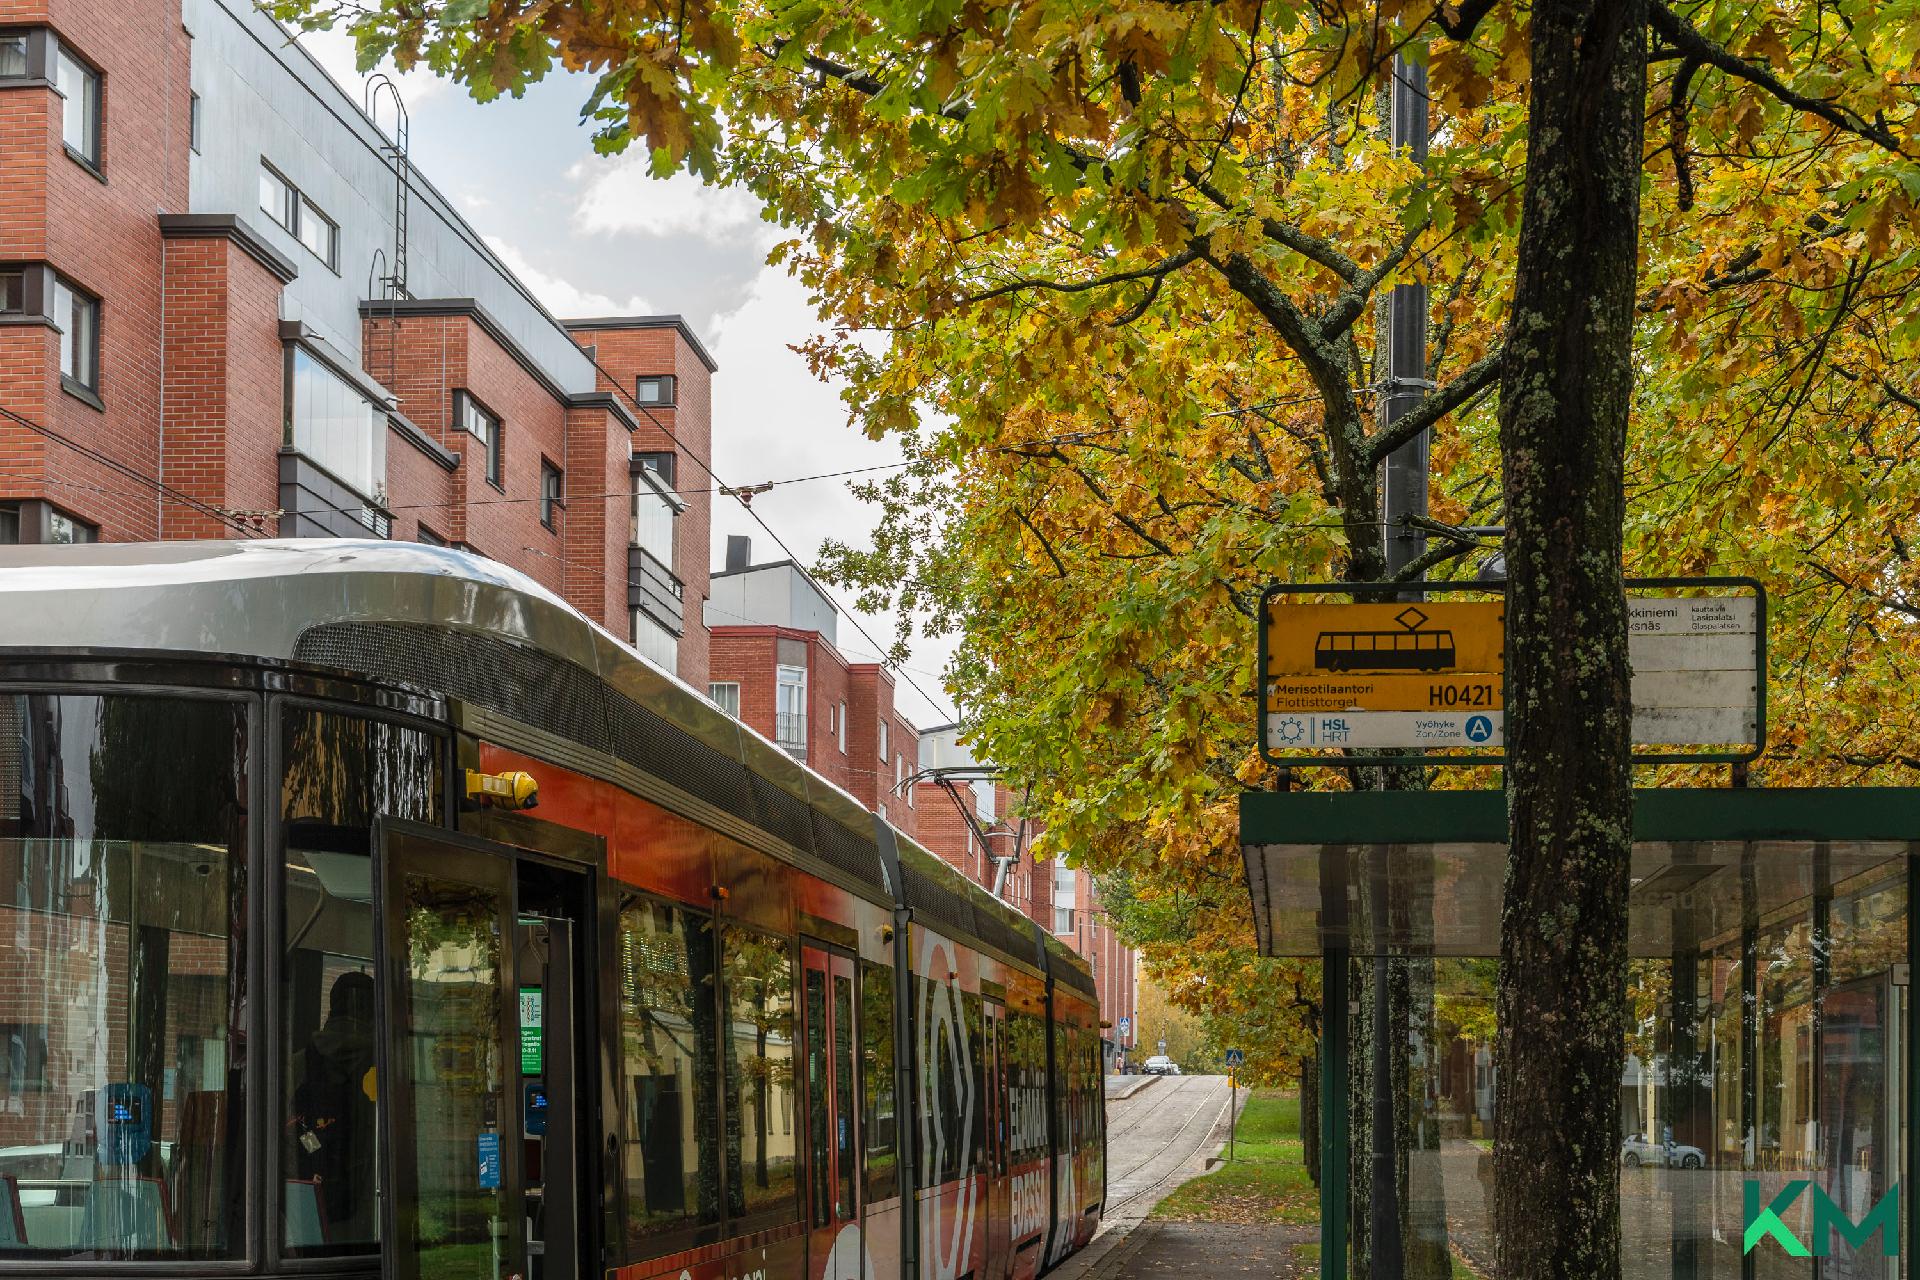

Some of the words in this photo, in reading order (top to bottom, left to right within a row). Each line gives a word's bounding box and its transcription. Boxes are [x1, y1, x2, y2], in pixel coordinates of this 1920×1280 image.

[1691, 613, 1736, 622] Lasipalatsi
[1276, 684, 1374, 695] Merisotilaantori
[1429, 685, 1493, 706] H0421
[1276, 697, 1358, 708] Flottisttorget
[1322, 719, 1350, 731] HSL
[1415, 720, 1455, 730] Vyöhyke
[1322, 731, 1350, 743] HRT
[1415, 730, 1461, 739] Zon/Zone
